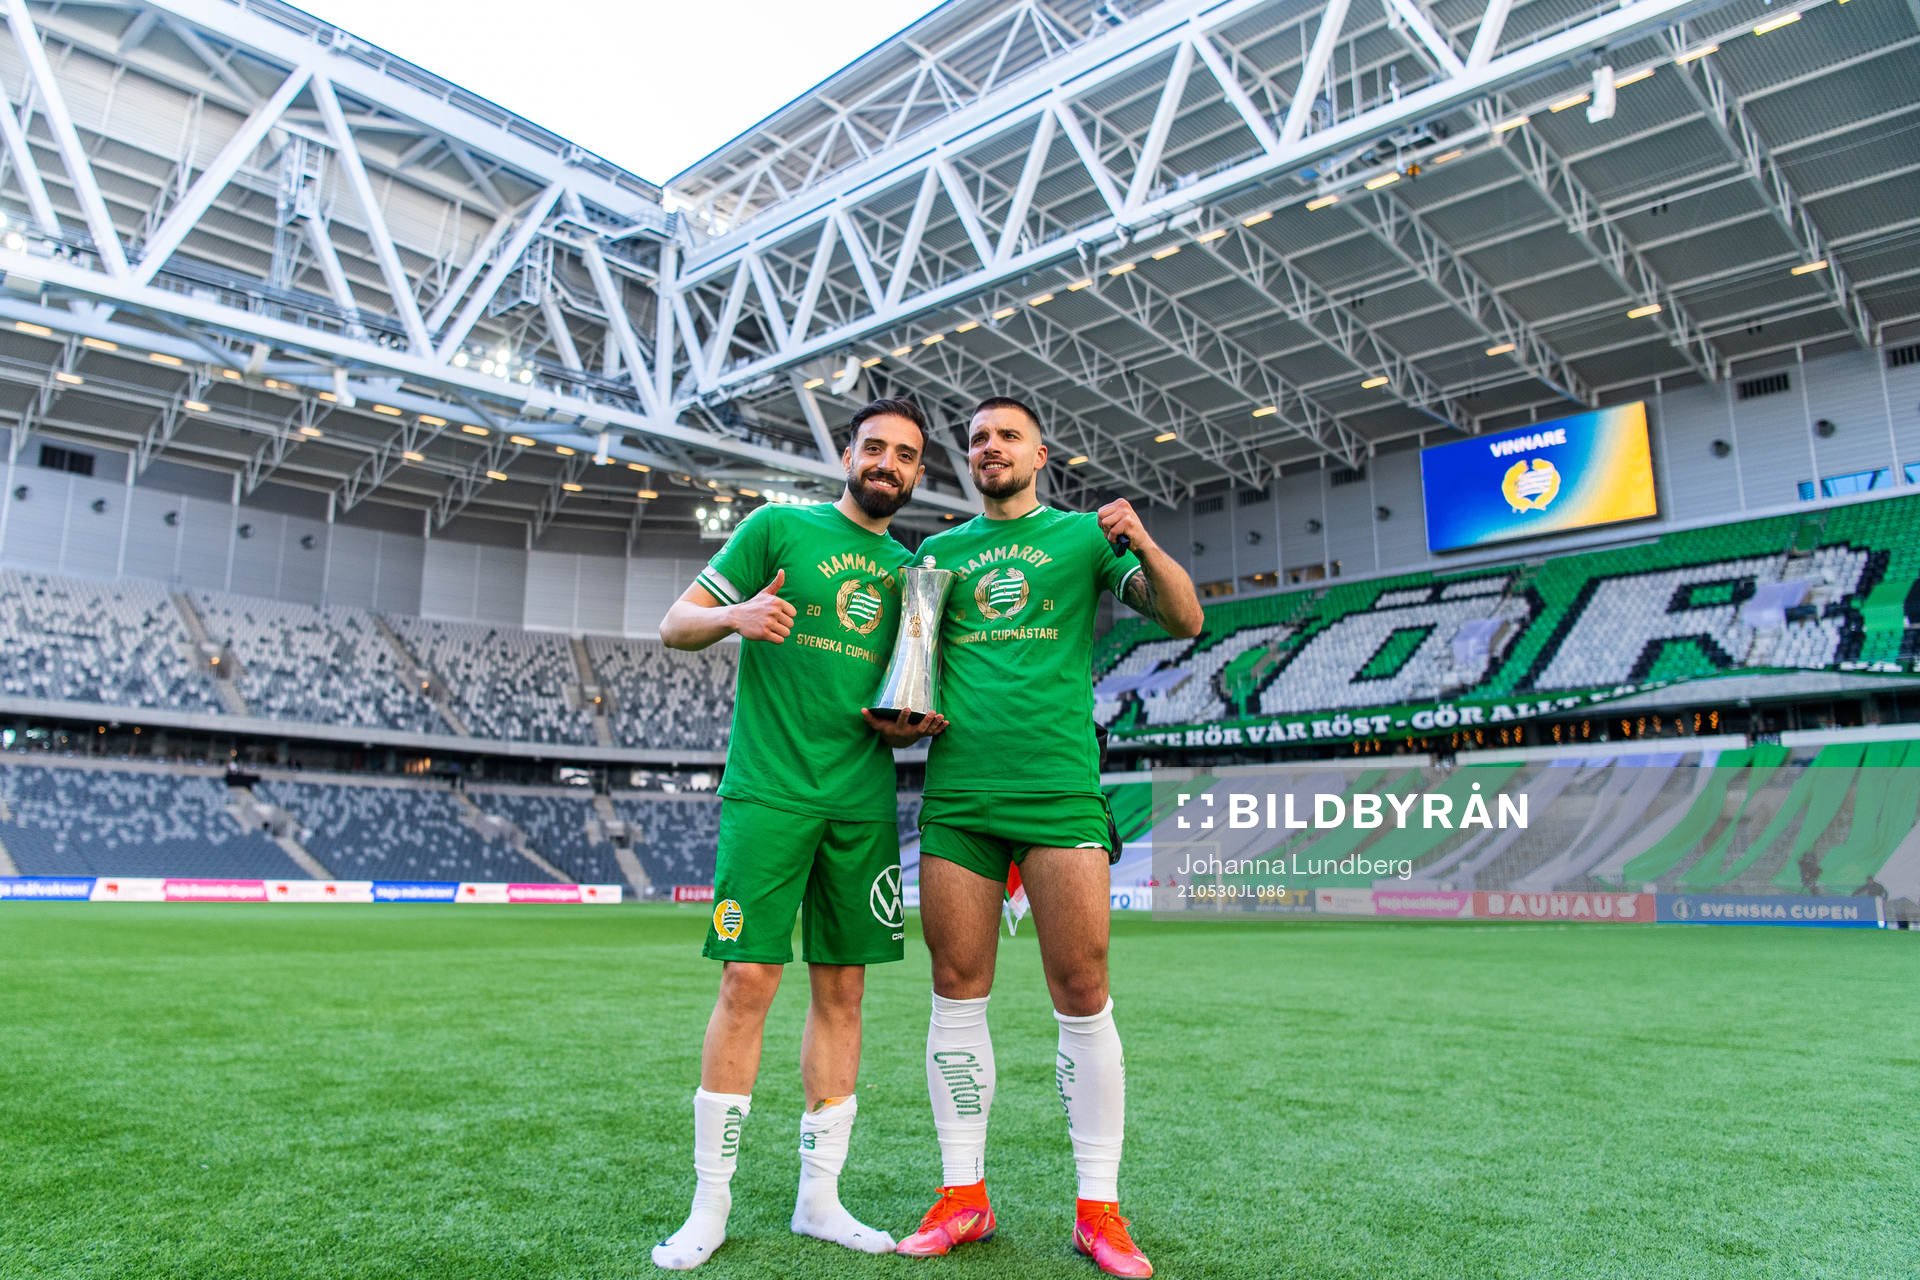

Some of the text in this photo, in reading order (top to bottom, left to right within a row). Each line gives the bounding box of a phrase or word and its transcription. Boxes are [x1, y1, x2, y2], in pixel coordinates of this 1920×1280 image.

[1490, 428, 1567, 457] VINNARE
[957, 544, 1053, 580] HAMMARBY
[806, 605, 821, 617] 20
[1042, 599, 1054, 611] 21
[991, 626, 1059, 641] CUPMÄSTARE
[796, 633, 842, 654] SVENSKA
[1185, 725, 1243, 747] HÖR
[1246, 720, 1306, 743] VÅR
[1311, 714, 1391, 738] RÖST
[1412, 704, 1484, 730] GÖR
[1487, 894, 1637, 918] BAUHAUS
[1700, 902, 1859, 920] SVENSKA CUPEN
[891, 932, 904, 941] CR
